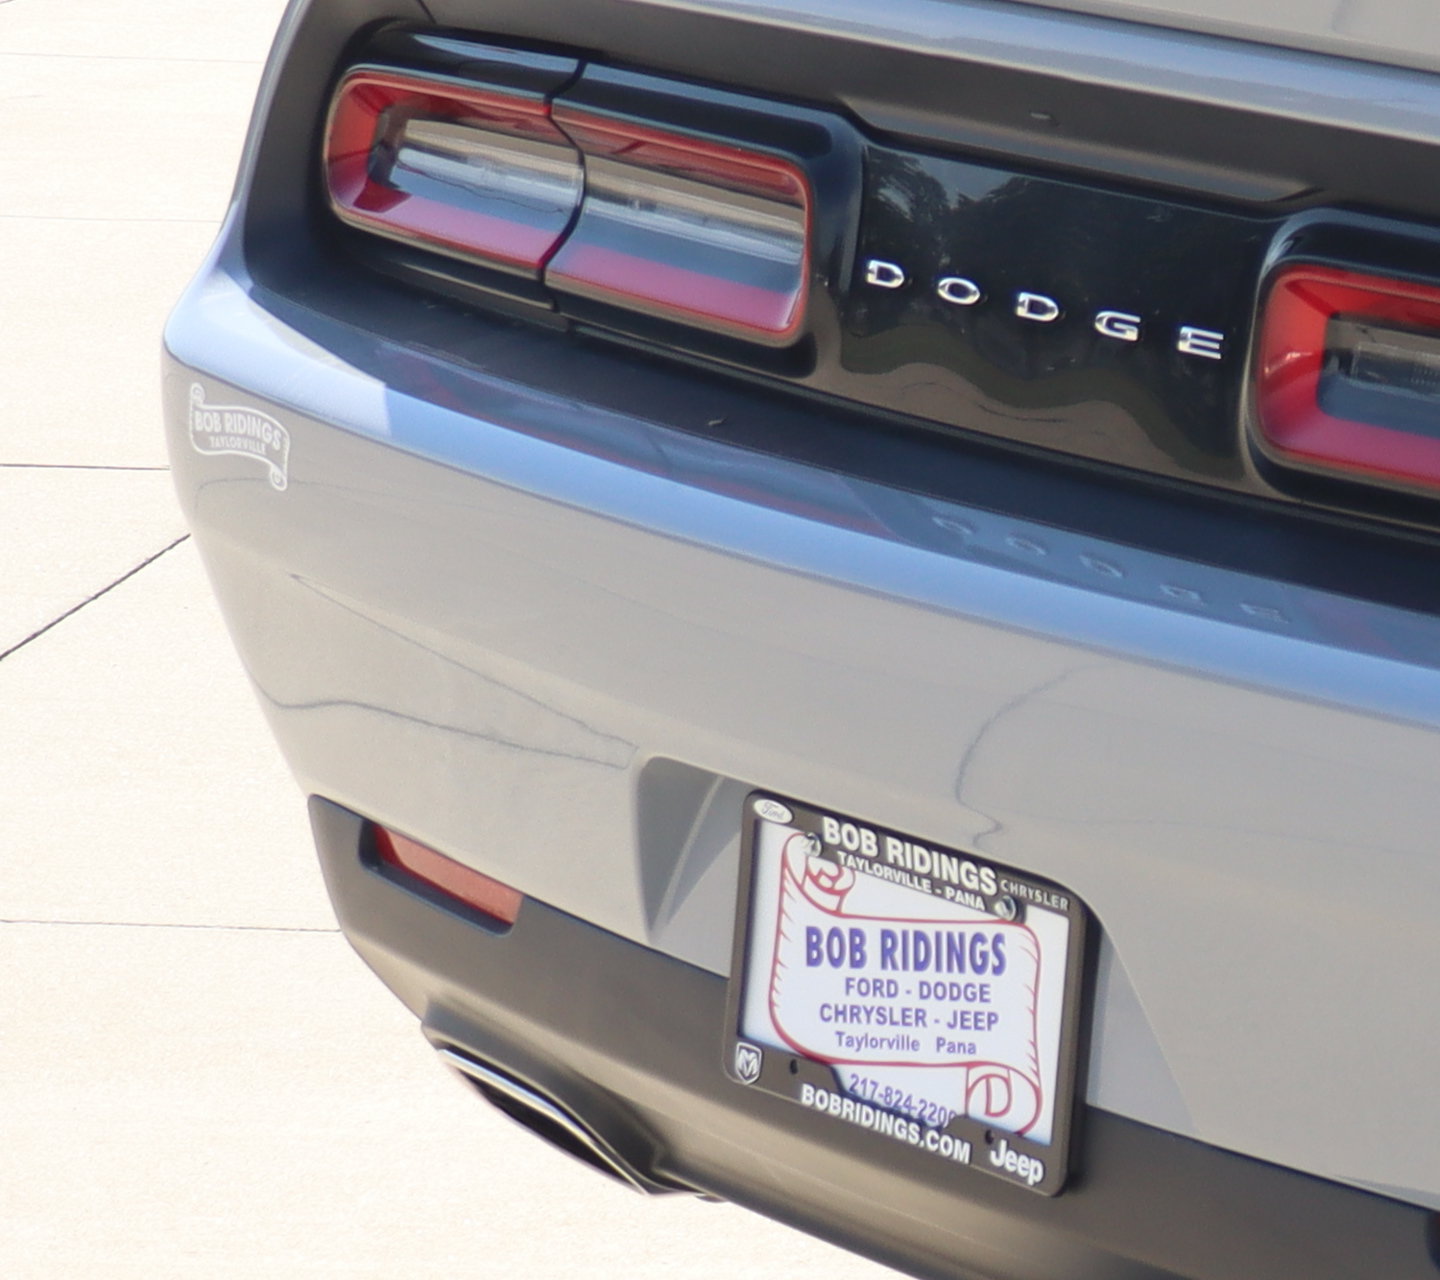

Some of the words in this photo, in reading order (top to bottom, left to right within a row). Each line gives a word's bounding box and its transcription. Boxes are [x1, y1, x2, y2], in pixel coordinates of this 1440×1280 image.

[867, 259, 1225, 360] DODGE
[195, 410, 221, 433] BOB
[225, 412, 282, 451] RIDINGS
[208, 435, 266, 455] TAYLORVILLE
[823, 816, 878, 857] BOB
[886, 836, 997, 896] RIDINGS
[837, 851, 932, 894] TAYLORVILLE
[945, 887, 986, 911] PANA
[1000, 879, 1069, 911] CHRYSLER
[805, 926, 867, 969] BOB
[880, 929, 1006, 976] RIDINGS
[845, 977, 899, 998] FORD
[919, 982, 991, 1003] DODGE
[819, 1003, 927, 1029] CHRYSLER
[947, 1009, 999, 1032] JEEP
[835, 1031, 920, 1053] Taylorville
[936, 1036, 977, 1055] Pana
[801, 1083, 972, 1165] BOBRIDINGS.COM
[989, 1139, 1044, 1186] Jeep
